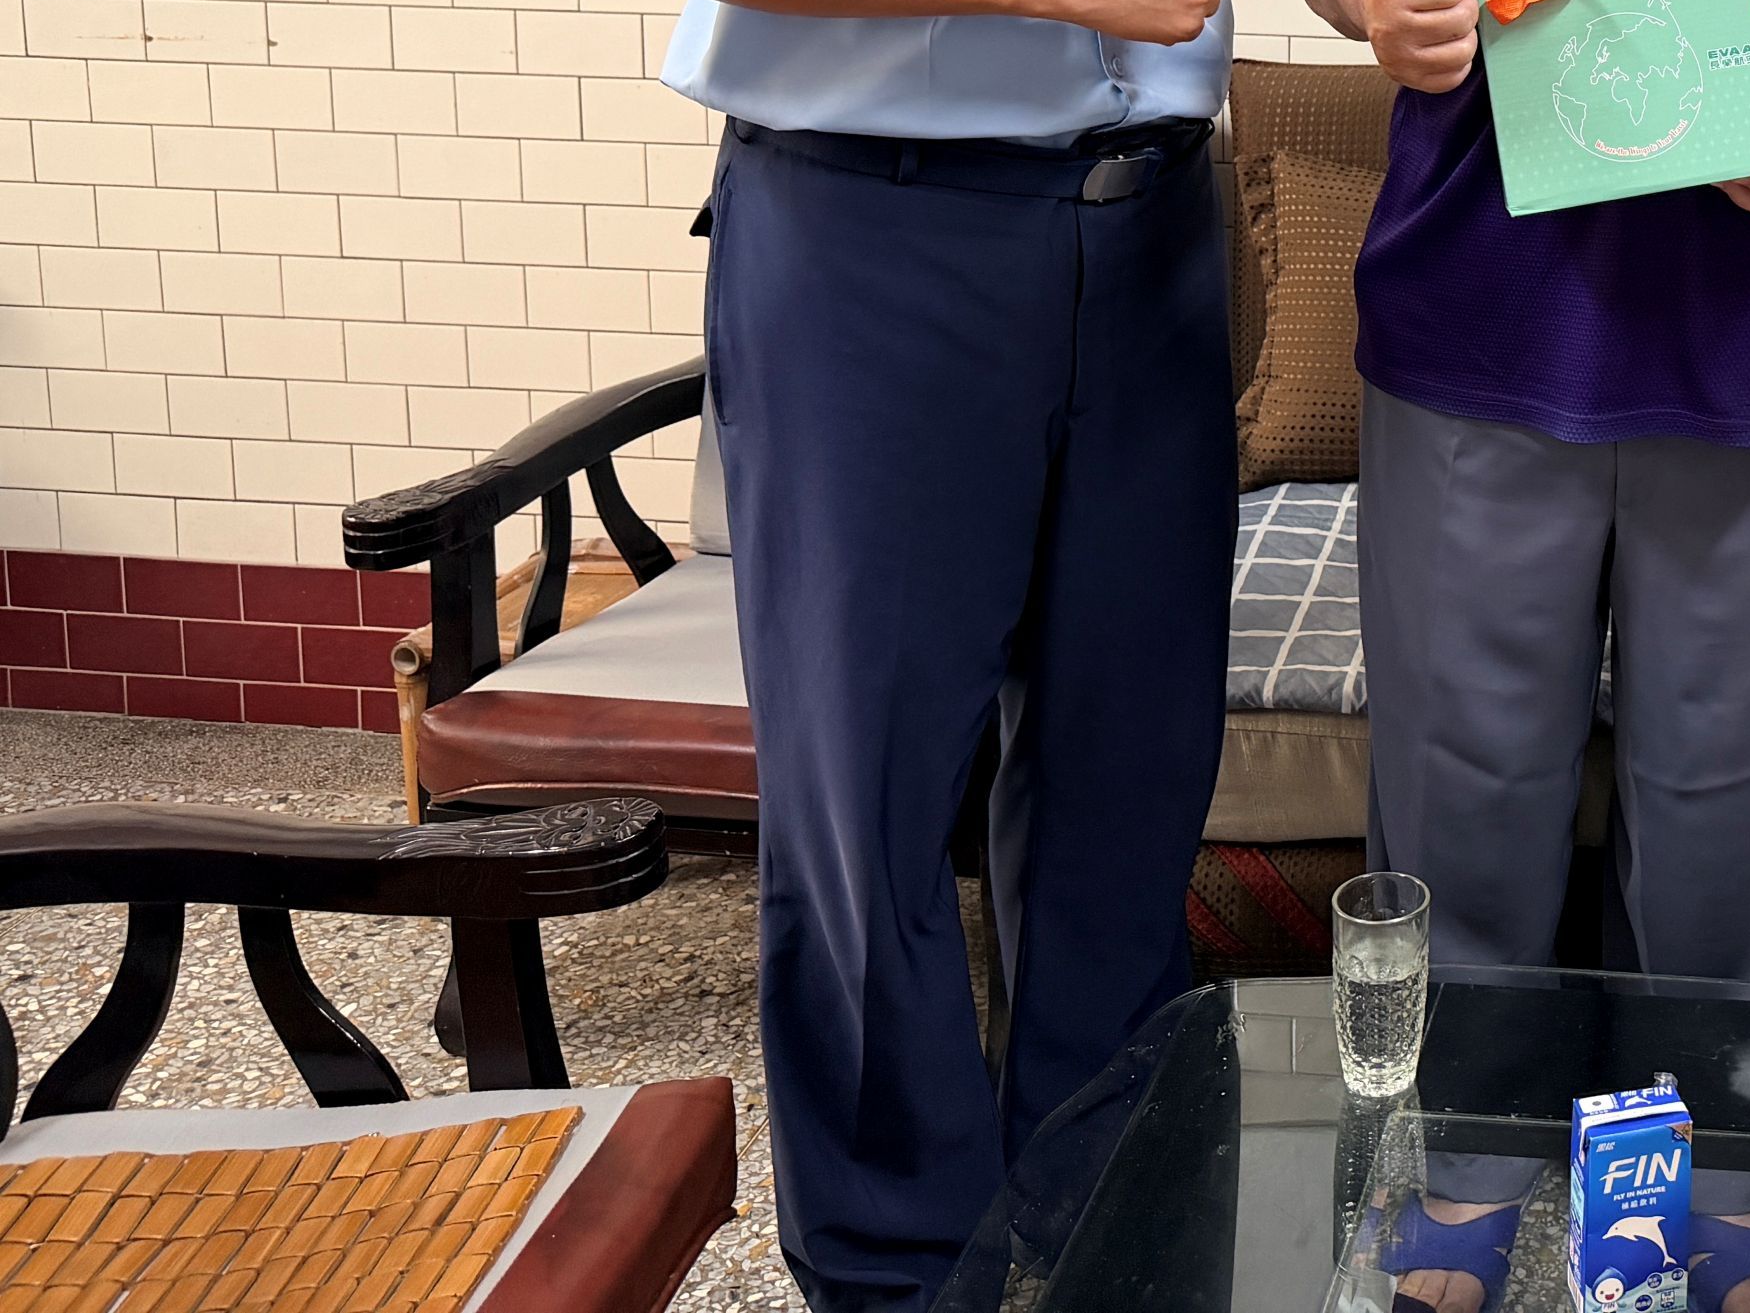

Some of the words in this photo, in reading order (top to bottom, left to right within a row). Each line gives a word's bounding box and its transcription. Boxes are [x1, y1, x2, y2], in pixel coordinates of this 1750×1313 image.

[1641, 1086, 1673, 1099] FIN
[1600, 1148, 1682, 1195] FIN
[1613, 1191, 1626, 1201] FLY
[1626, 1190, 1635, 1200] IN
[1636, 1186, 1666, 1197] NATURE
